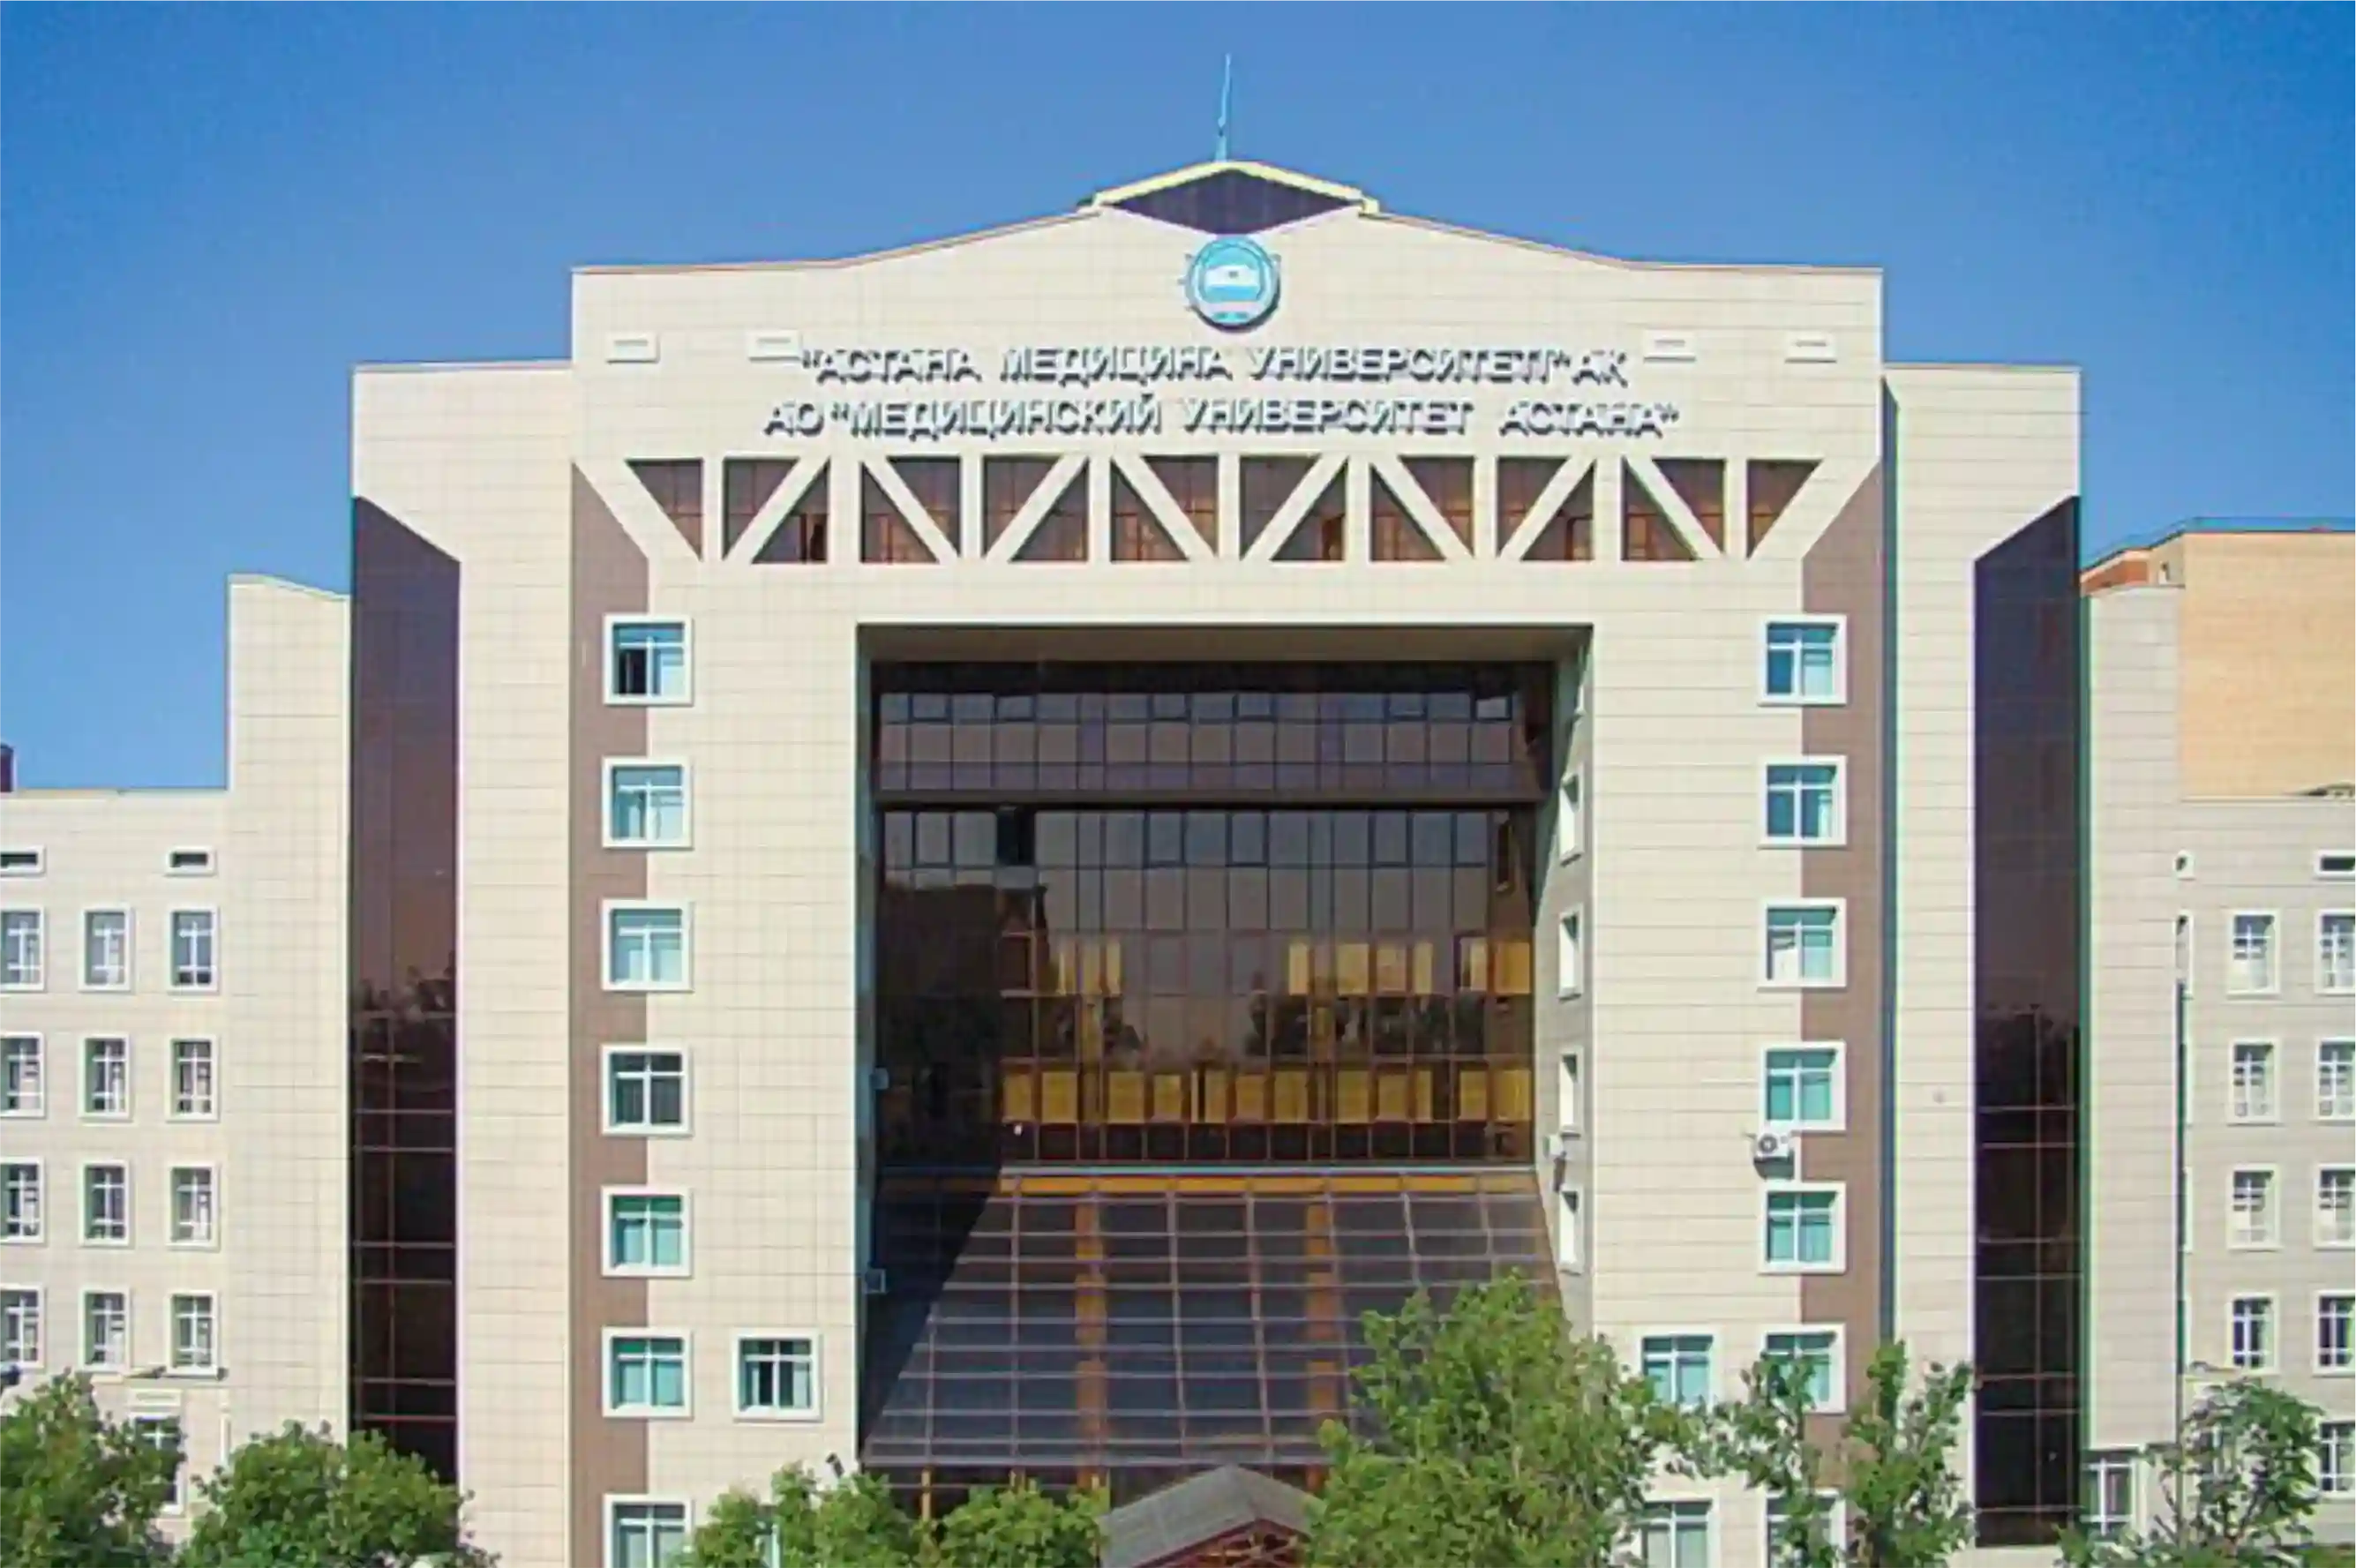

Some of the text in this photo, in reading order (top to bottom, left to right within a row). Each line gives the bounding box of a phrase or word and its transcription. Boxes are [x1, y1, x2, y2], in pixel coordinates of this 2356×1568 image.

[999, 345, 1234, 388] МЕДИЦИНА
[764, 400, 825, 438] АО
[1182, 398, 1474, 436] УНИВЕРСИТЕТ
